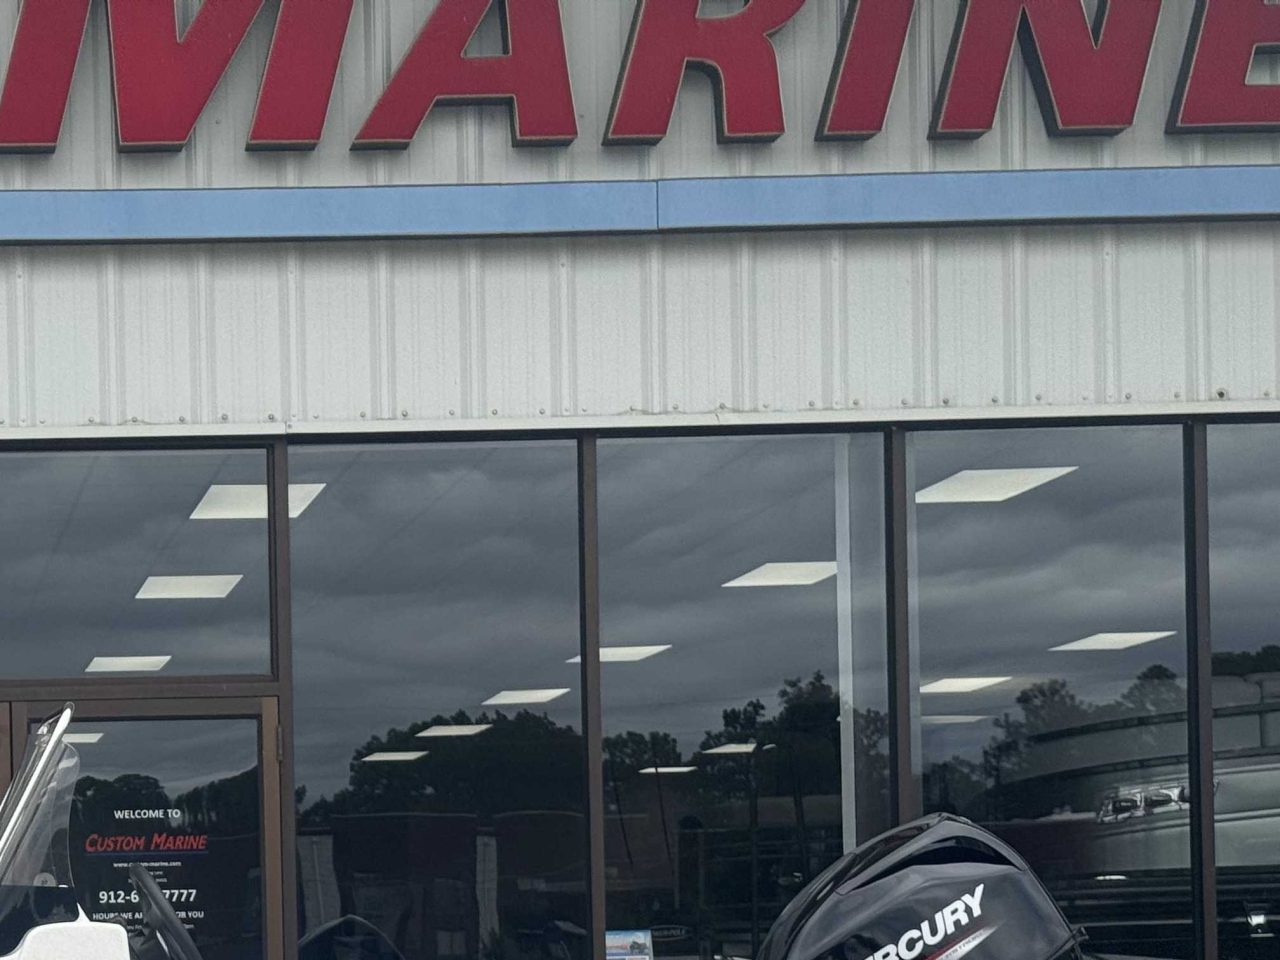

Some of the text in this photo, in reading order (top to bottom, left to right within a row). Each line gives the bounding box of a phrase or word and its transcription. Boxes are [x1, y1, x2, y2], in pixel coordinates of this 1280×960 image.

[114, 809, 181, 819] WELCOME TO
[85, 832, 208, 852] CUSTOM MARINE
[98, 889, 197, 904] 912-67777
[188, 910, 204, 918] YOU
